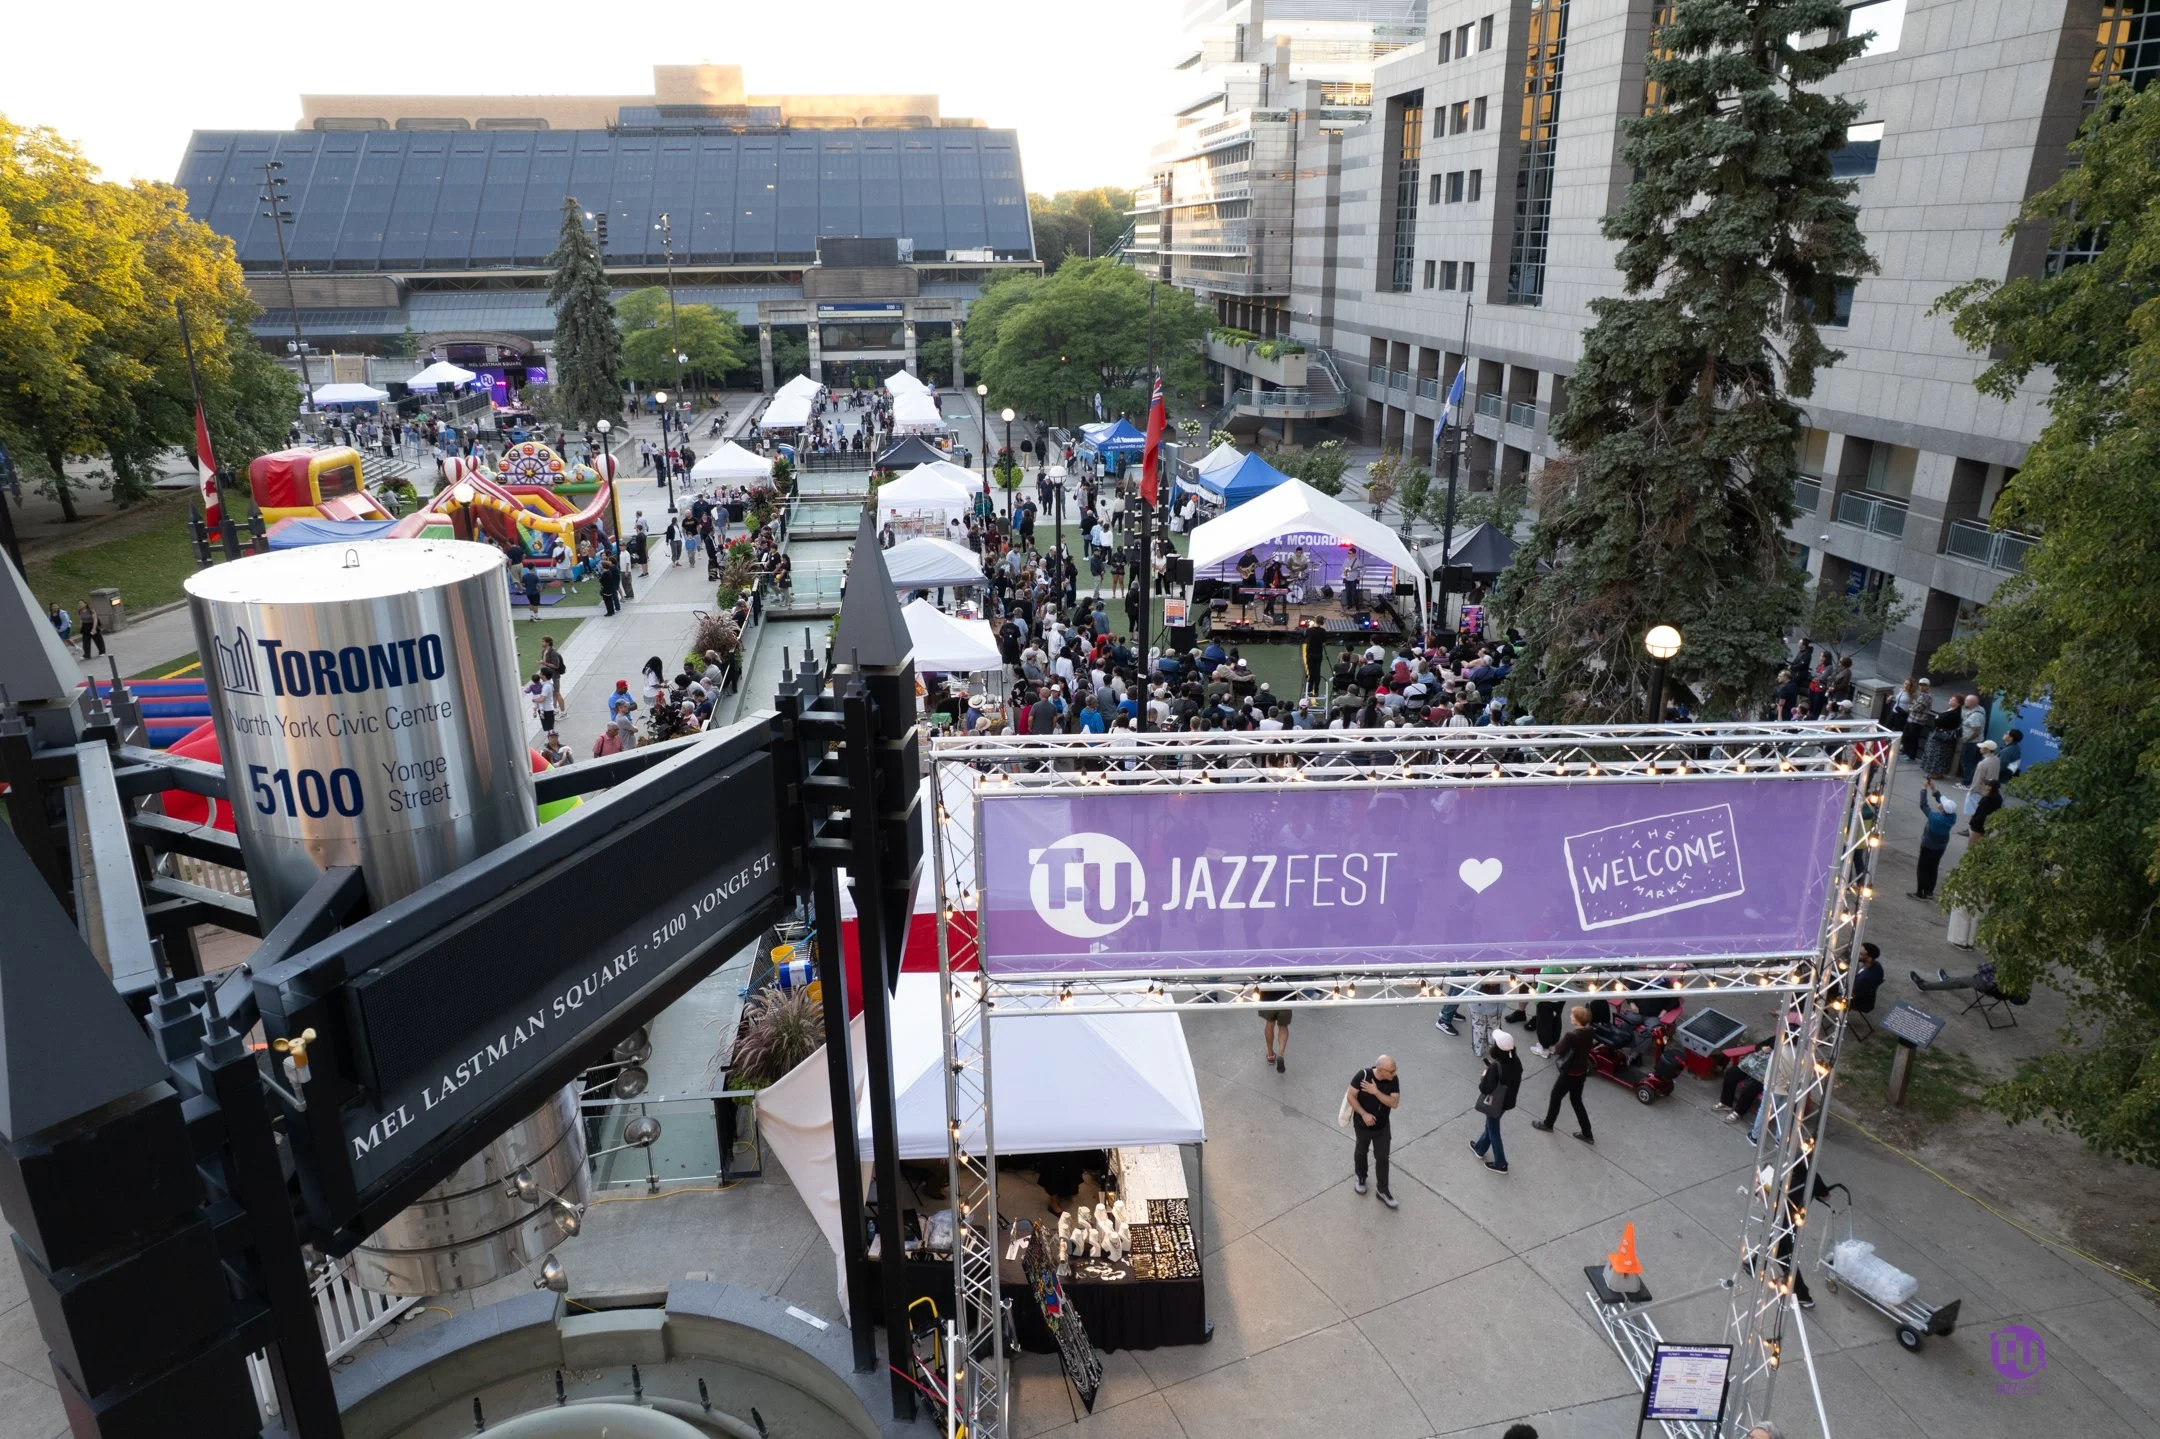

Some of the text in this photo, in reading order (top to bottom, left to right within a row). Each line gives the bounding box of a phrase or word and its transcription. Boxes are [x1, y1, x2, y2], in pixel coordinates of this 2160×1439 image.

[258, 634, 445, 697] TORONTO
[228, 701, 452, 738] North York Civic Centre
[248, 764, 364, 819] 5100
[382, 756, 447, 784] Yonge
[388, 781, 452, 813] Street
[1583, 830, 1726, 894] WELCOME
[1632, 829, 1675, 849] THE
[1162, 852, 1398, 911] JAZZFEST
[1633, 872, 1692, 899] MARKET
[351, 852, 777, 1161] MEL LASTMAN SQUARE 5100 YONGE ST.
